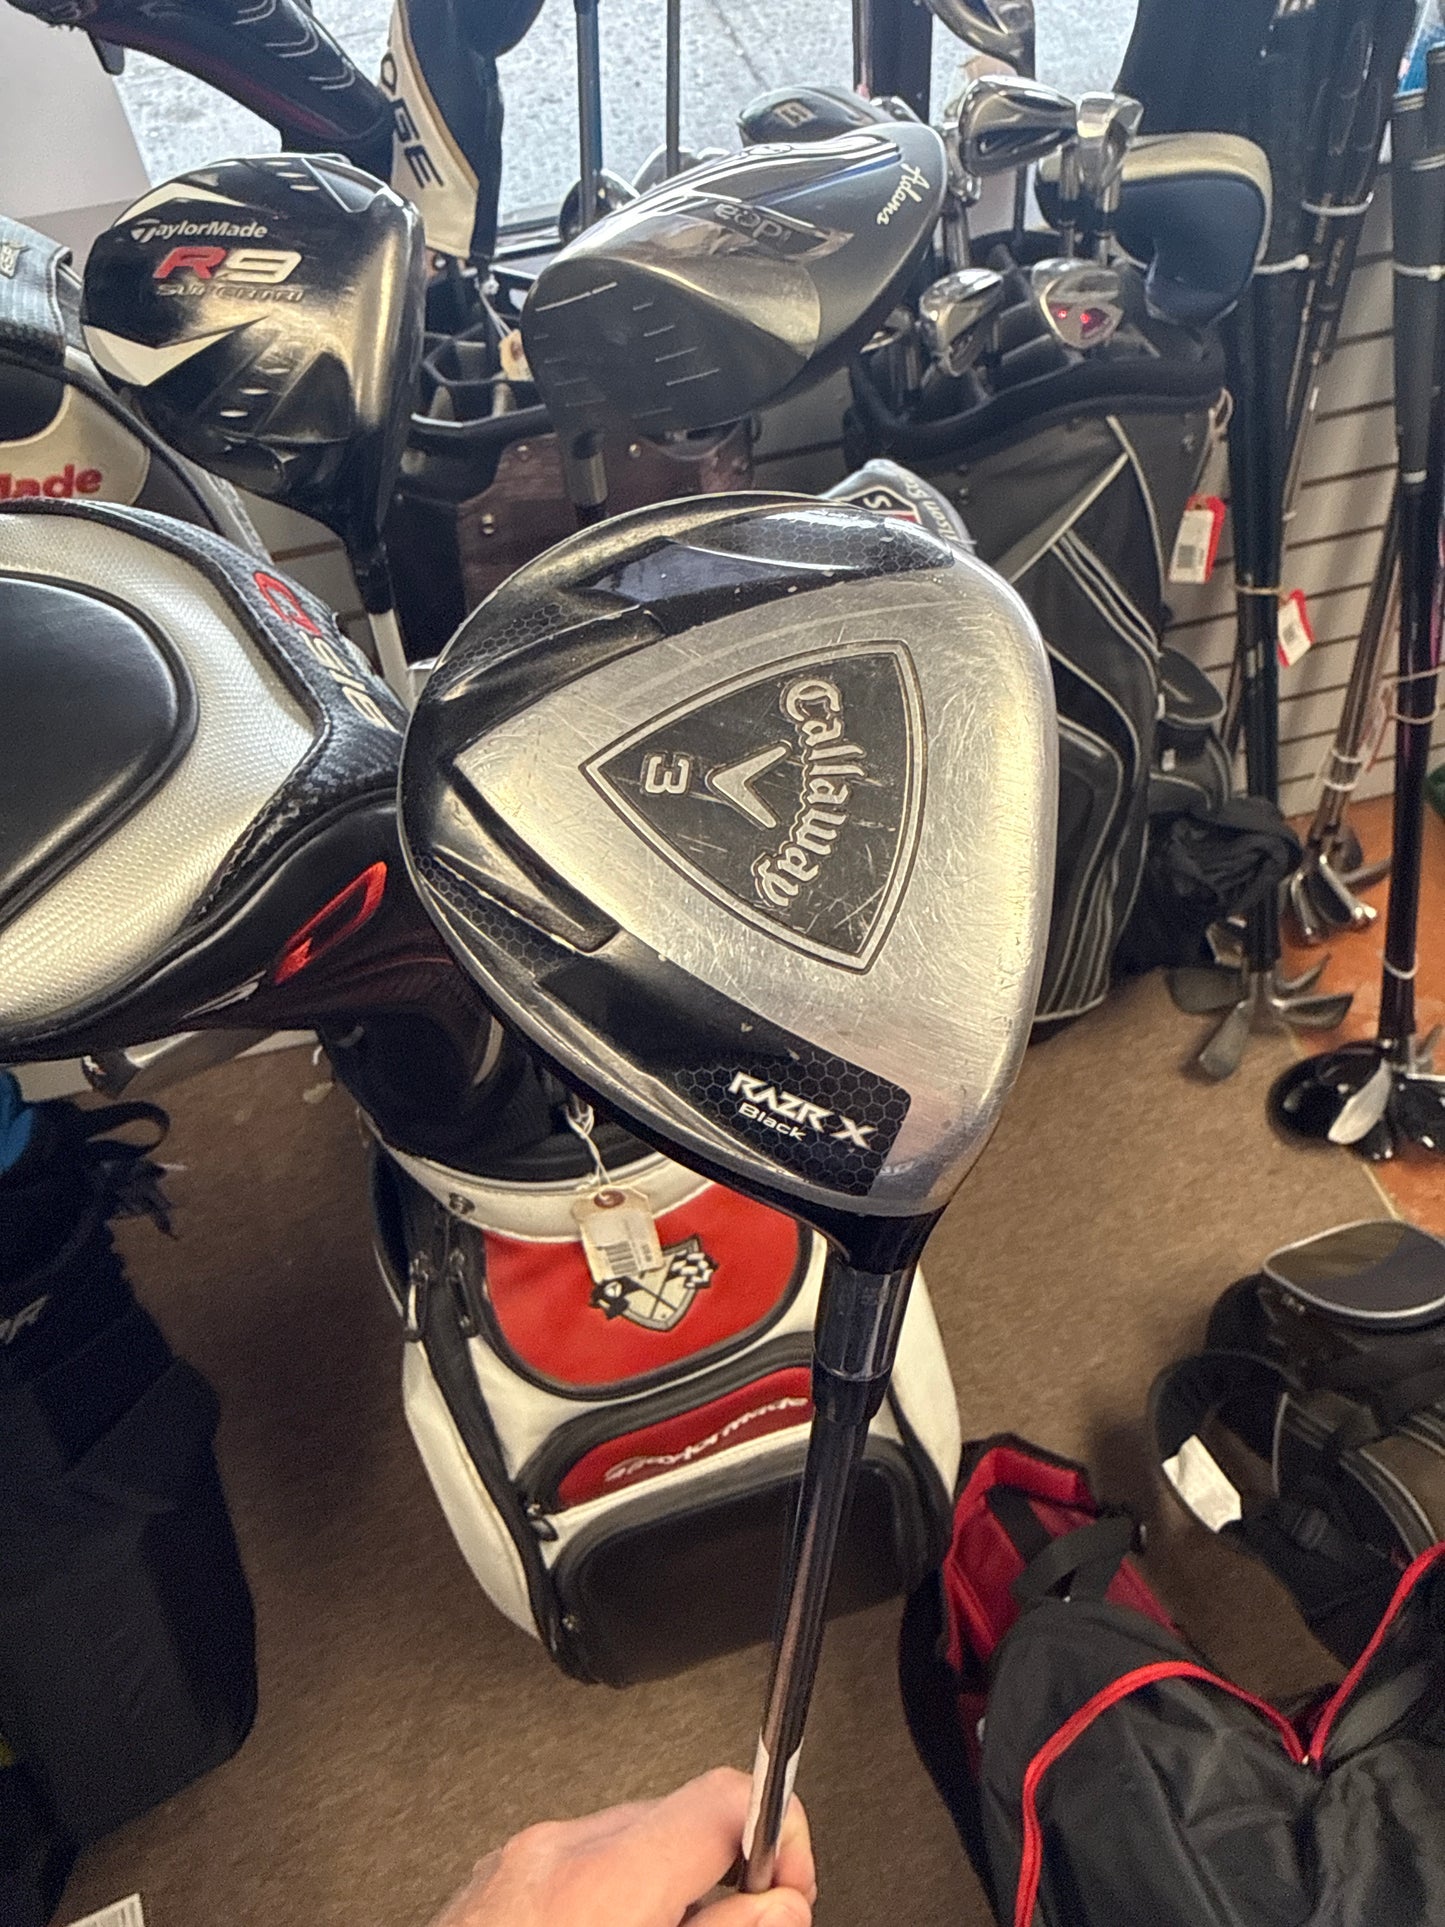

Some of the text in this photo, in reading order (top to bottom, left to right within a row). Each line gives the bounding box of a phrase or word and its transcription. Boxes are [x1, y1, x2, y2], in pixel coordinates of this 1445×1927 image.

[876, 163, 930, 225] Adams
[130, 218, 269, 244] TaylorMade
[153, 246, 302, 284] R9
[643, 751, 691, 795] 3
[751, 678, 868, 909] Callaway
[727, 1071, 878, 1150] RAZR X
[738, 1102, 806, 1142] Black
